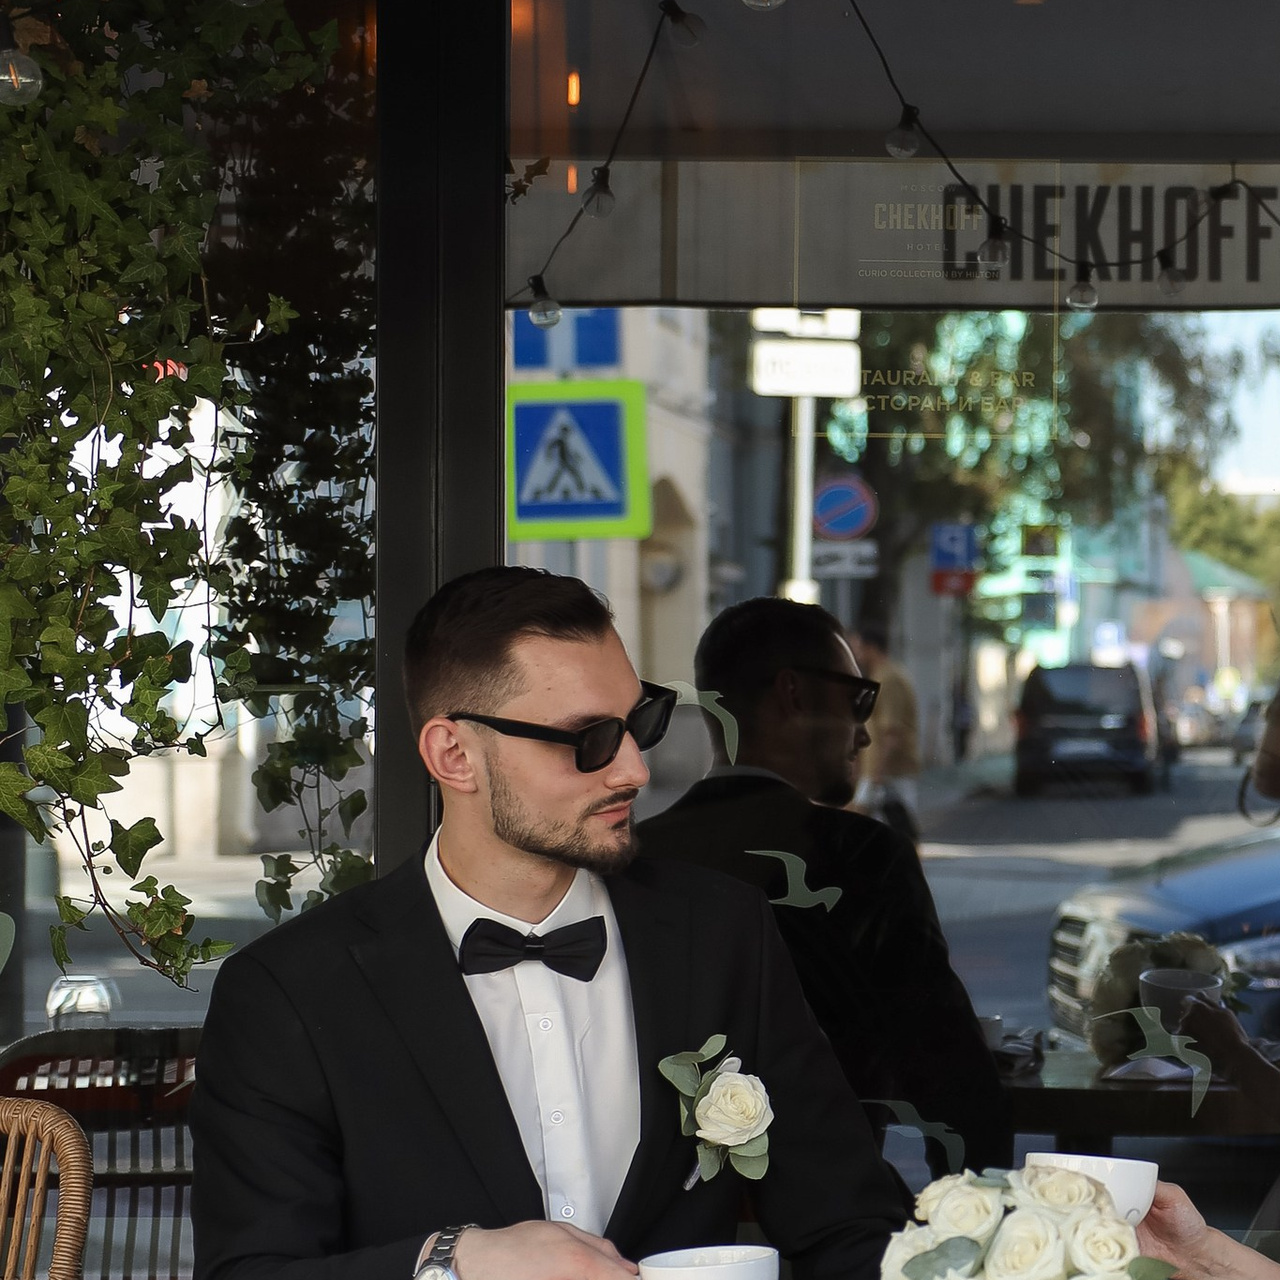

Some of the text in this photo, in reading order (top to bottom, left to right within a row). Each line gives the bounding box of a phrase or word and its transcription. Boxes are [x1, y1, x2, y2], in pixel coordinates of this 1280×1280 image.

[901, 184, 957, 193] MOSCOW
[874, 203, 983, 230] CHEKHOFF
[943, 185, 1278, 282] CHEKHOFF
[906, 243, 949, 252] HOTEL
[858, 269, 1000, 280] CURIO COLLECTION BY HILTON
[969, 371, 983, 387] &
[862, 394, 951, 412] СТОРАН
[959, 396, 973, 412] И
